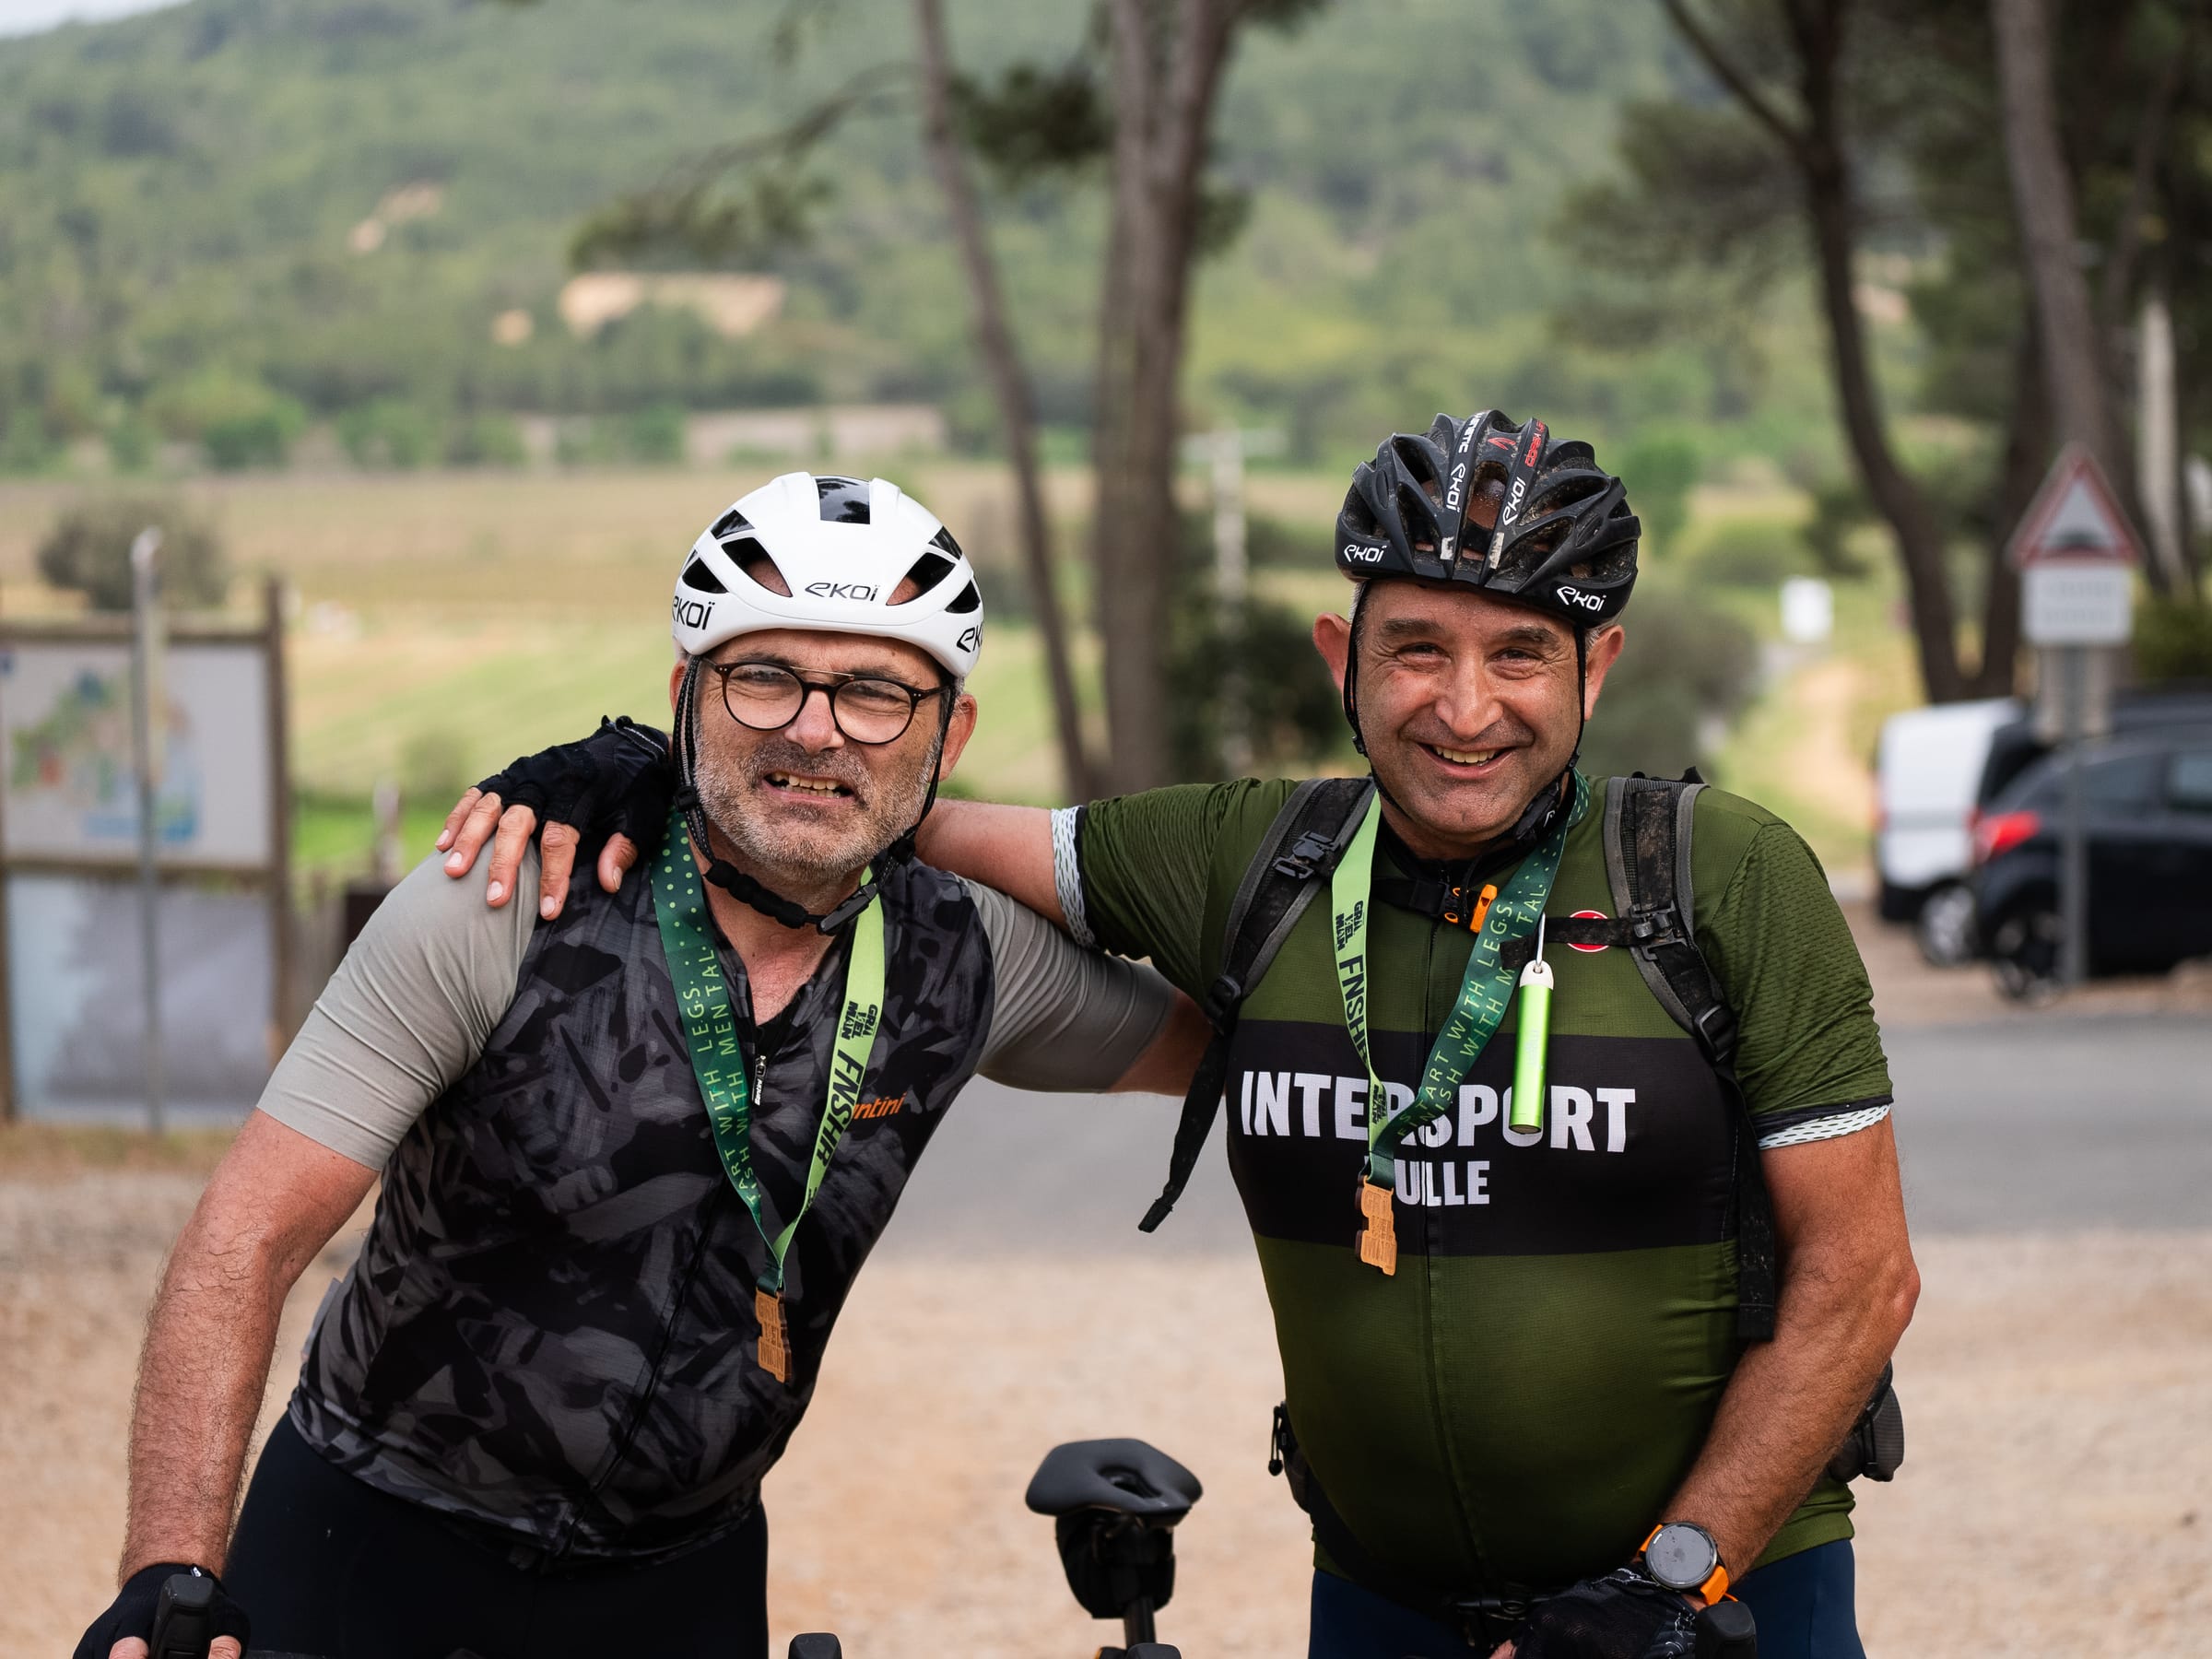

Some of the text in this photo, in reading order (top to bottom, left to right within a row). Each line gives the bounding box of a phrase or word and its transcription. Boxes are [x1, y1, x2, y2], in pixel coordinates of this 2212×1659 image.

[1459, 997, 1503, 1057] WITH
[1495, 888, 1547, 986] MTAL
[1446, 981, 1486, 1040] WITH
[703, 1069, 733, 1135] WITH
[726, 1071, 748, 1136] WITH
[853, 1092, 908, 1119] ntini
[1364, 1155, 1490, 1206] ULLE
